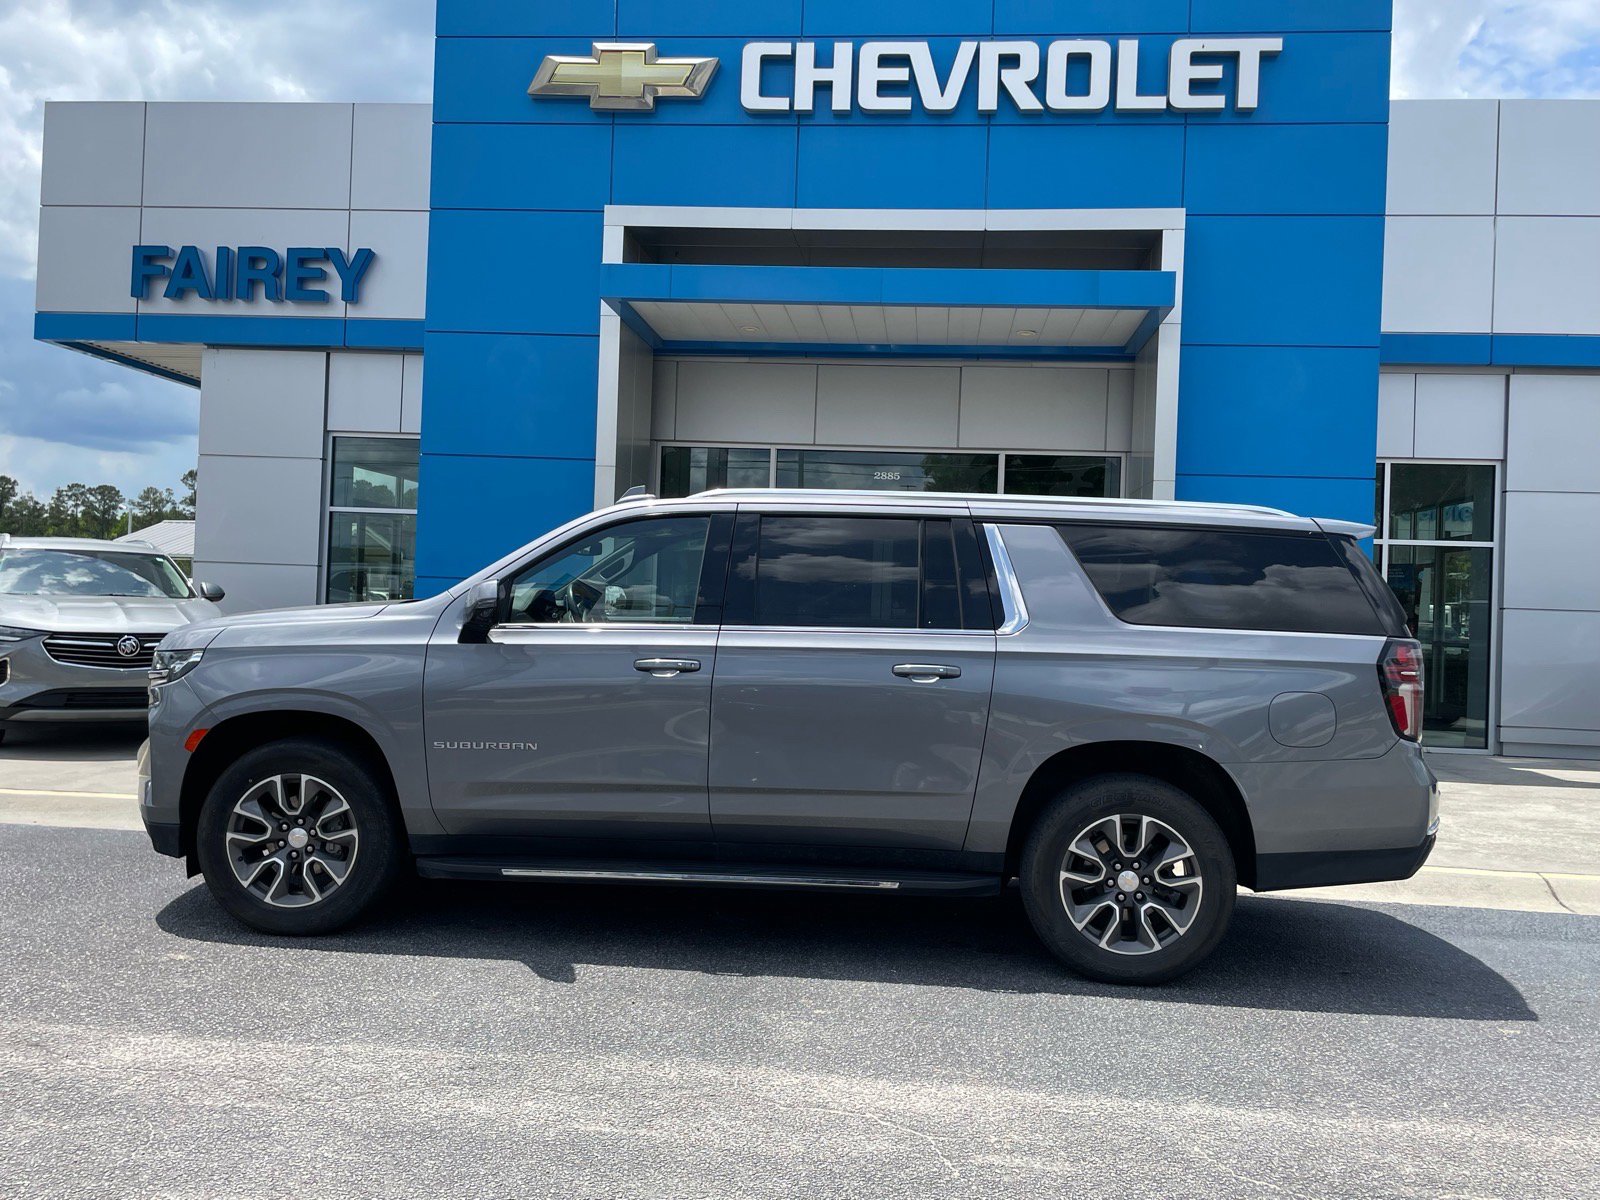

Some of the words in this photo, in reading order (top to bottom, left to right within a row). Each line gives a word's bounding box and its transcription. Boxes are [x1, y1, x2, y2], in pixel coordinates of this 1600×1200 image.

[741, 37, 1283, 114] CHEVROLET
[130, 245, 376, 304] FAIREY
[873, 471, 900, 480] 2885
[433, 741, 538, 750] SUBURBAN
